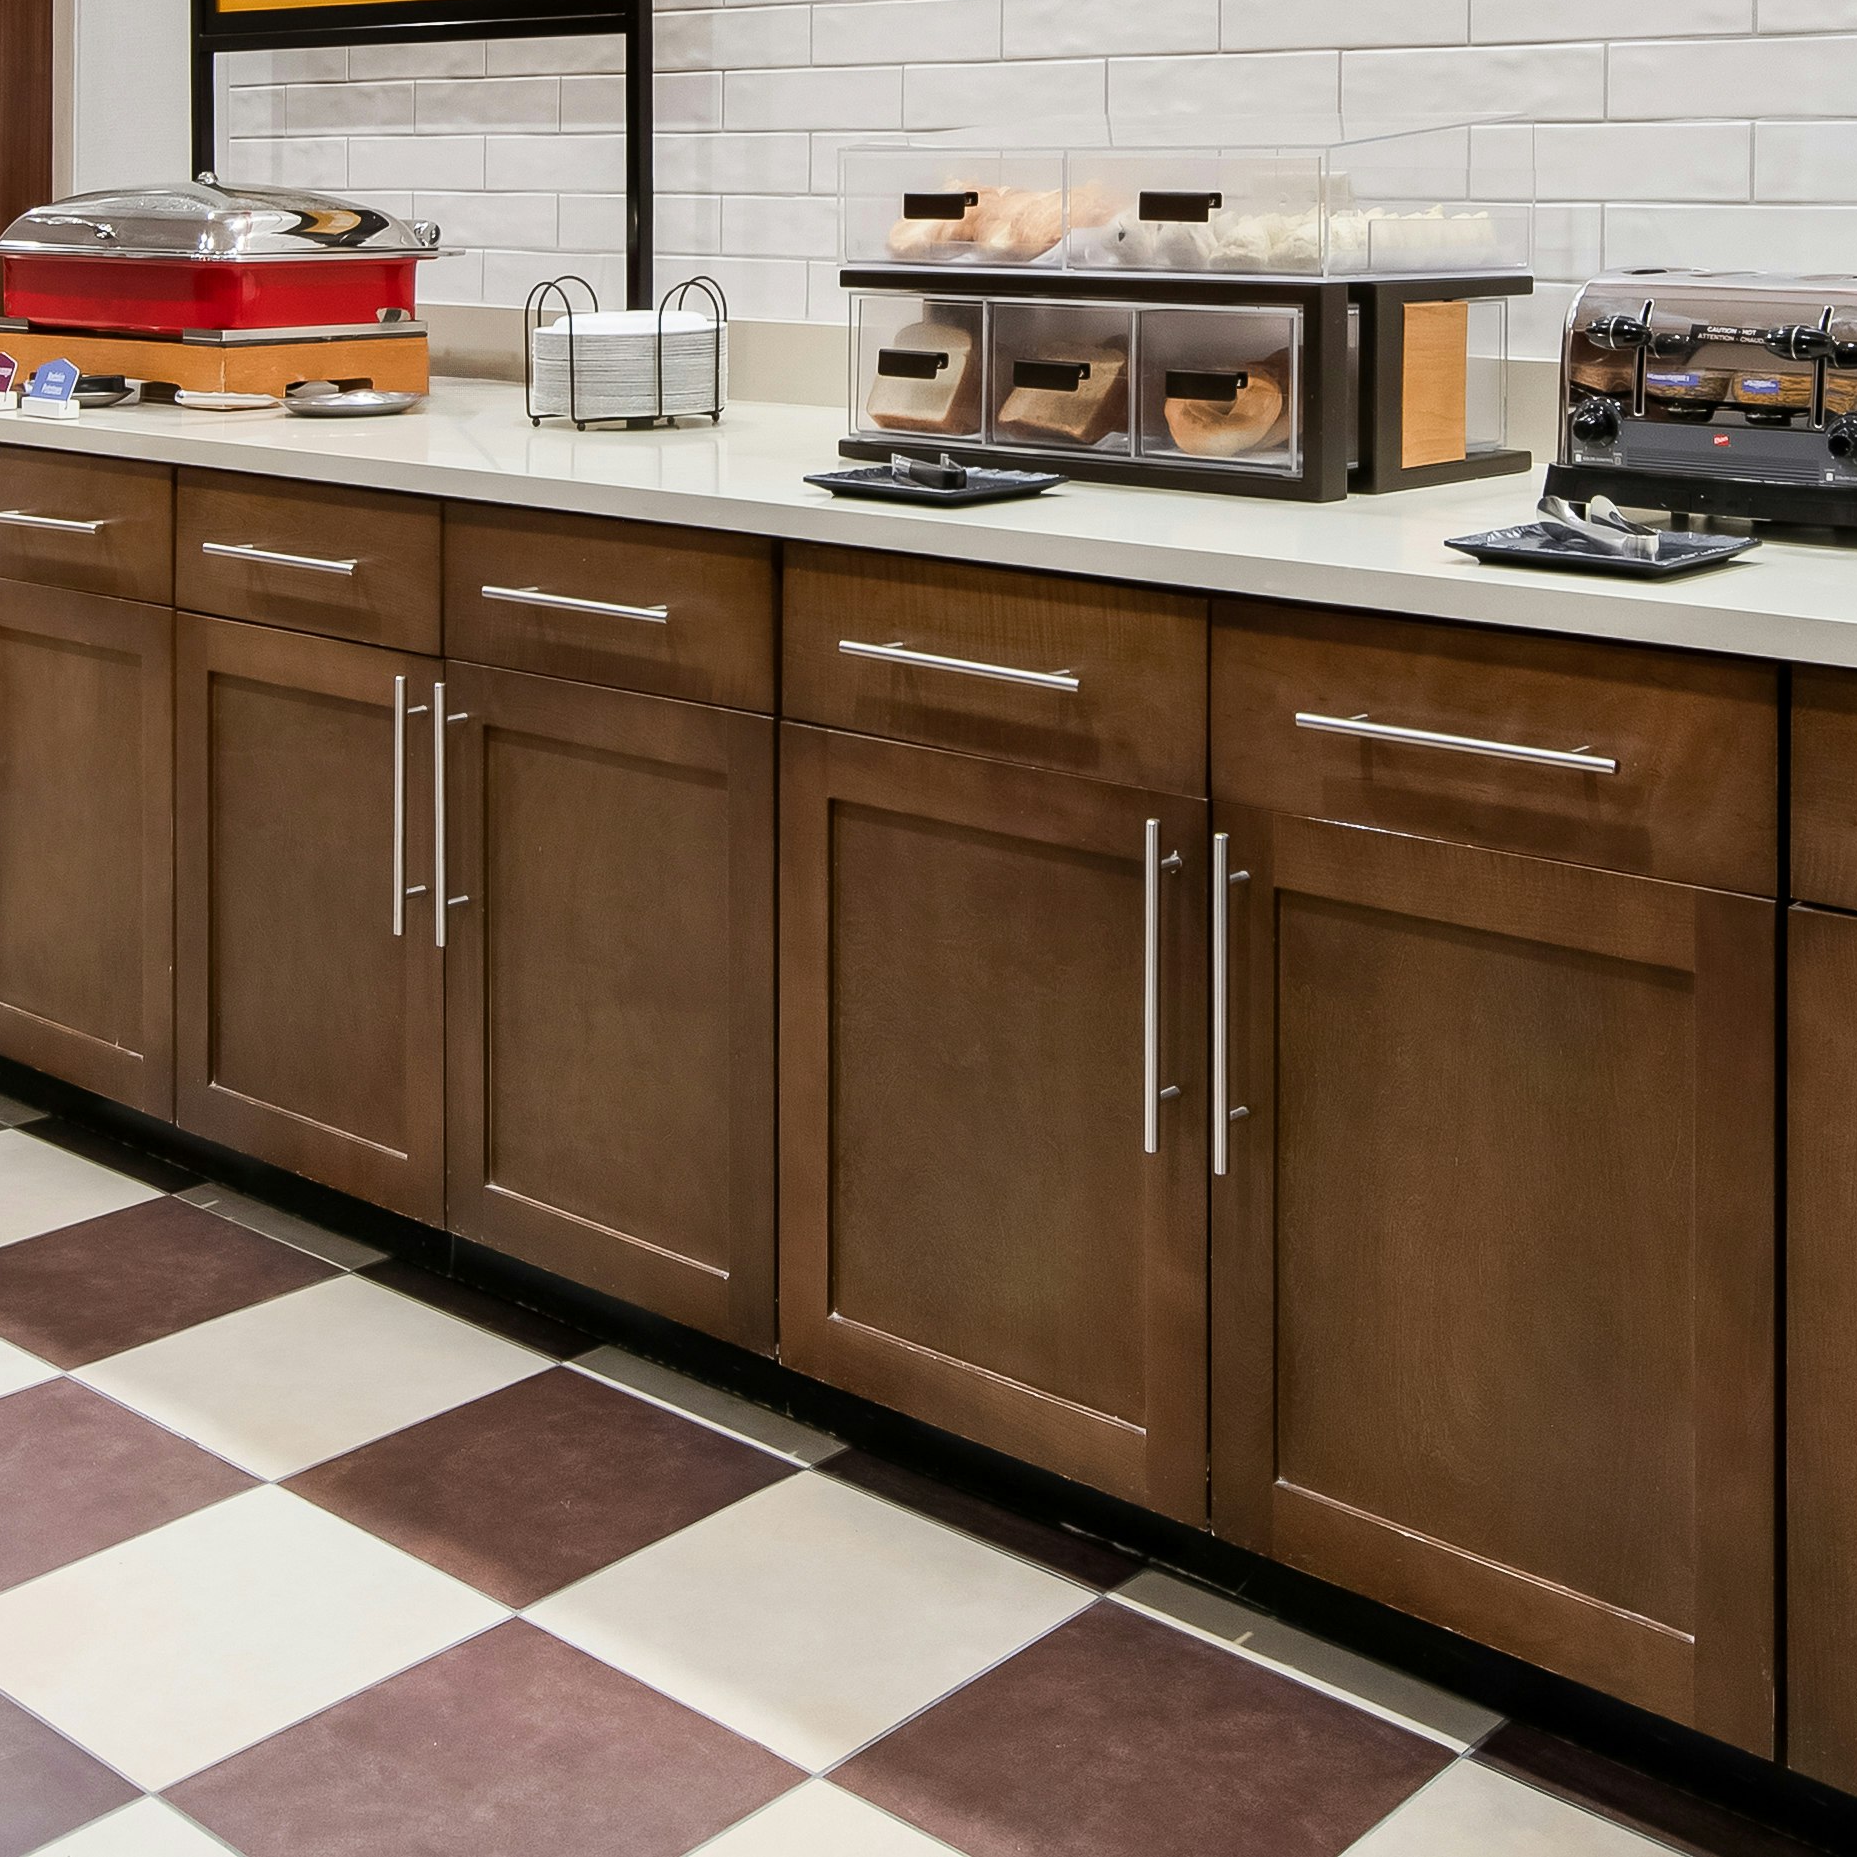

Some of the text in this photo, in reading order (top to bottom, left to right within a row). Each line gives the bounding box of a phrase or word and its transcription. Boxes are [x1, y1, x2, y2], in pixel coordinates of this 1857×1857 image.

[1707, 326, 1737, 334] CAUTION
[1698, 333, 1765, 344] ATTENTION CHAUD
